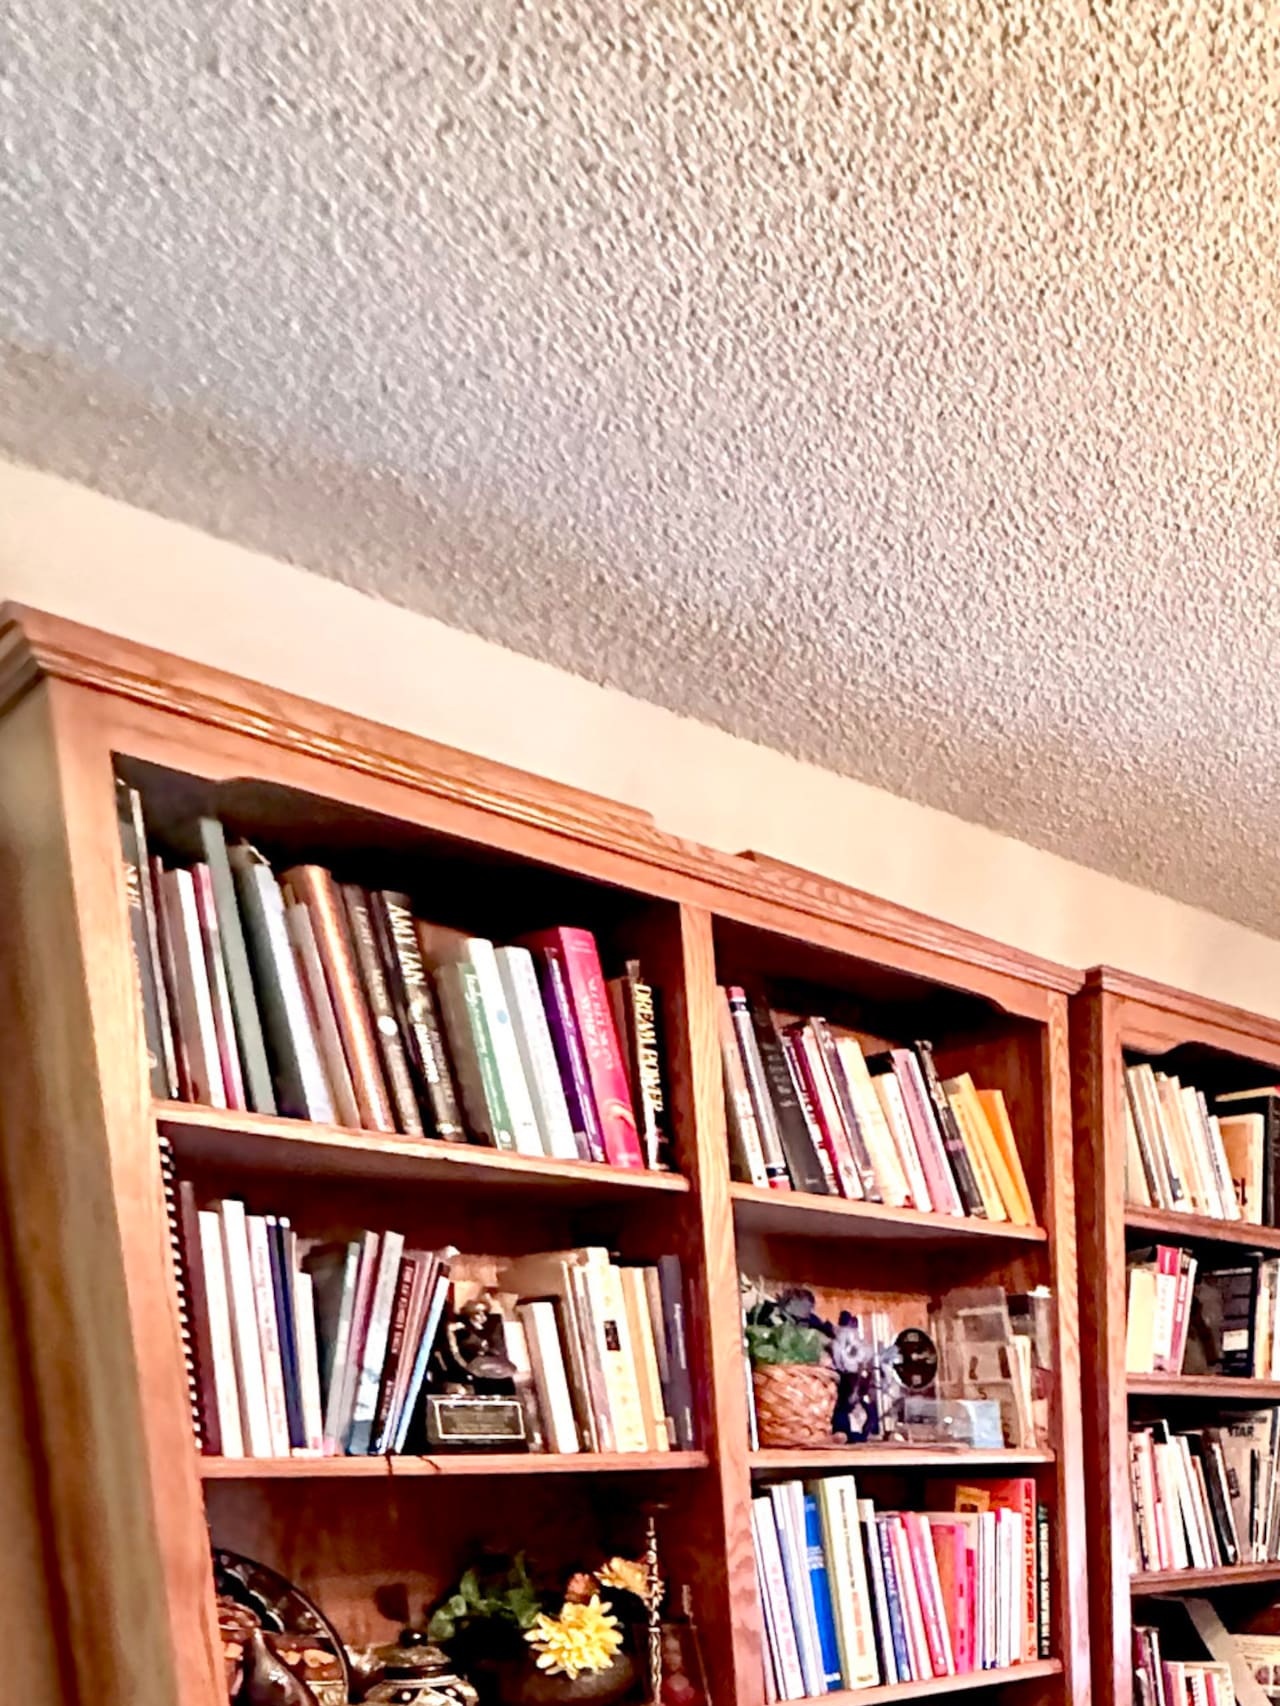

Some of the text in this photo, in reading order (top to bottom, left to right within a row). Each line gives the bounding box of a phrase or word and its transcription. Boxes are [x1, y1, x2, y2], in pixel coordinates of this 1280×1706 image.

[386, 898, 418, 951] AMY
[633, 984, 664, 1112] DREAM POWER
